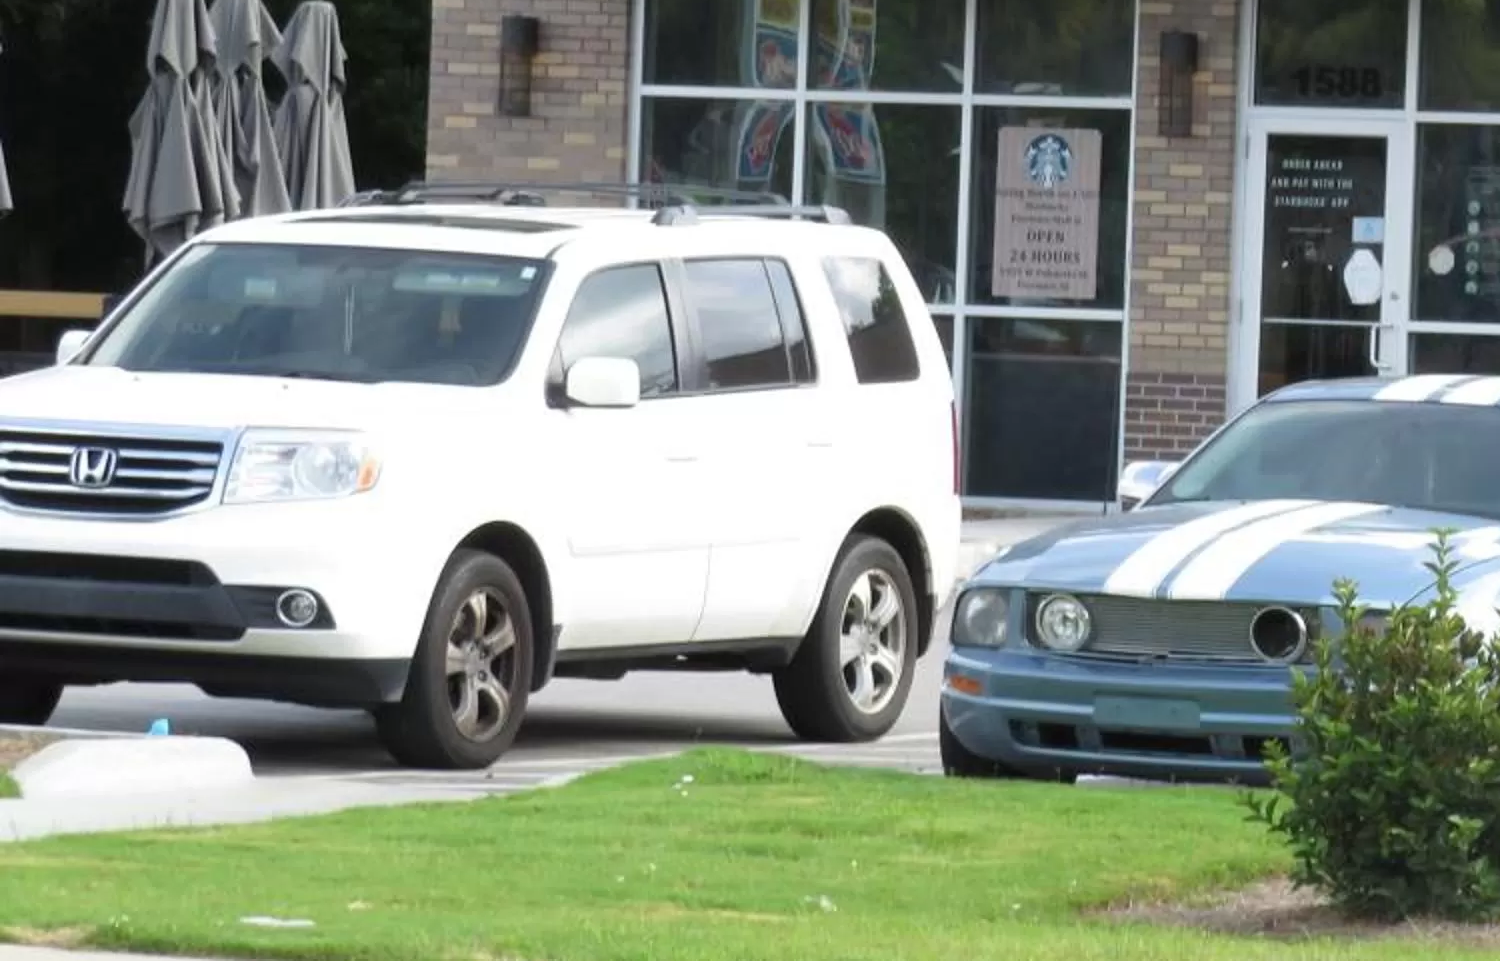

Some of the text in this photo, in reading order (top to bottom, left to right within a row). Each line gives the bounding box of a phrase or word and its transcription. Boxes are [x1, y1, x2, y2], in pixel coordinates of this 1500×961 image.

[1290, 65, 1383, 98] 1588
[1026, 229, 1065, 243] OPEN
[1032, 249, 1081, 264] HOURS
